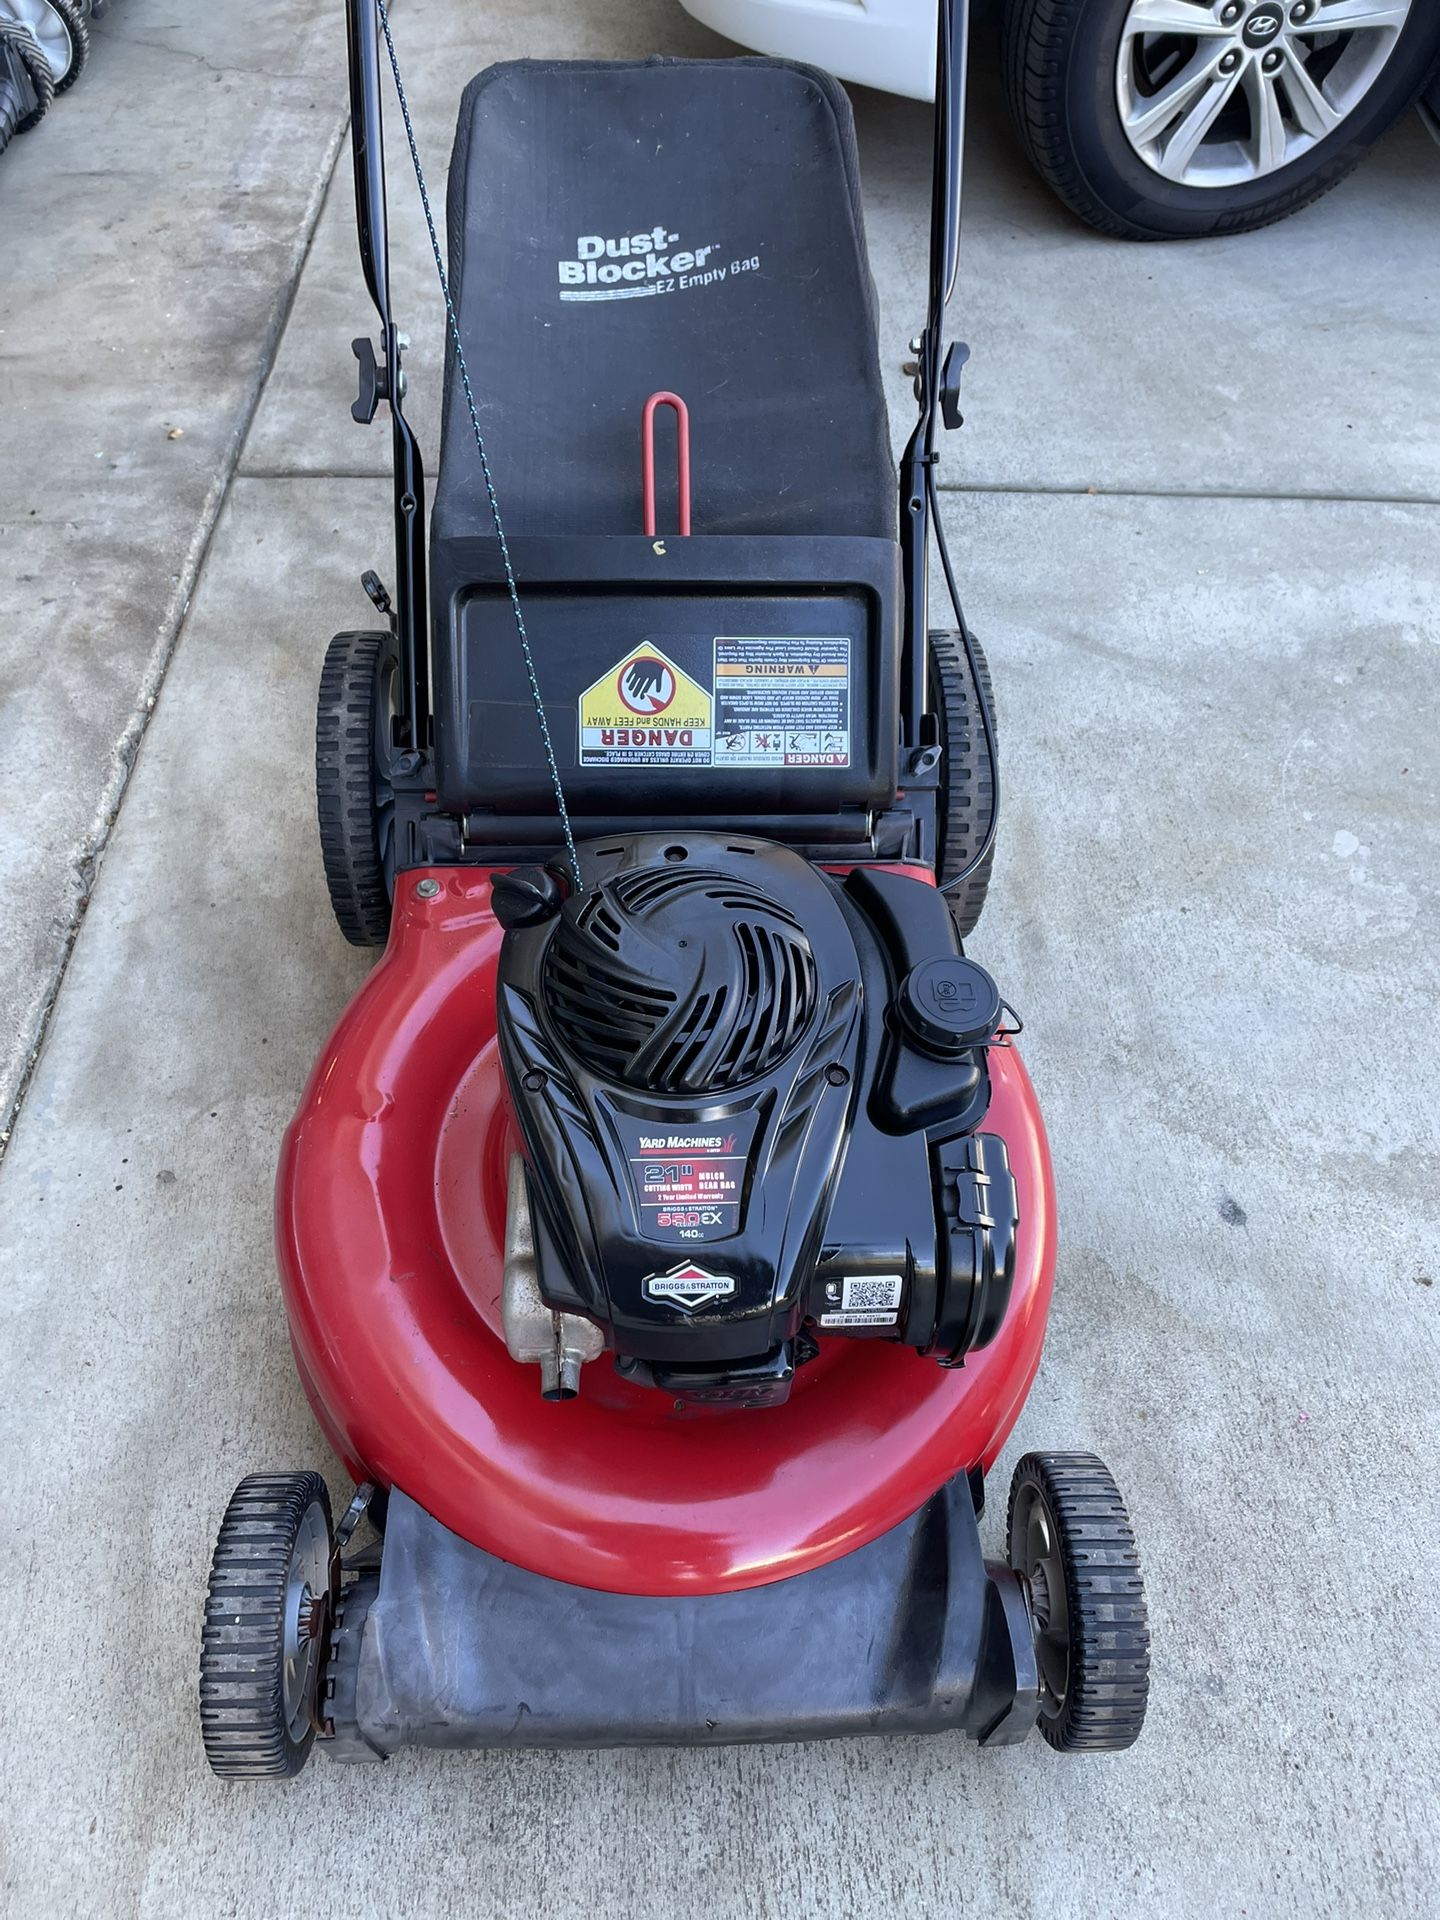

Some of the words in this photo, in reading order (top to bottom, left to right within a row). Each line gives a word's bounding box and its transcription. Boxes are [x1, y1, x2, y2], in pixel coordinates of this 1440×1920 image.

[577, 226, 680, 260] Dust-
[656, 278, 675, 294] EZ
[680, 268, 727, 290] Empty
[730, 256, 760, 275] Bag
[746, 665, 804, 674] WARNING
[587, 717, 611, 726] AWAY
[614, 717, 634, 726] FEET
[636, 717, 650, 726] and
[653, 717, 681, 726] HANDS
[684, 717, 705, 726] KEEP
[601, 729, 692, 746] DANGER
[788, 754, 834, 764] DANGER
[638, 1137, 666, 1148] YARD
[667, 1136, 722, 1148] MACHINES
[698, 1172, 725, 1180] MULCH
[699, 1181, 718, 1189] REAR
[720, 1181, 736, 1189] BAG
